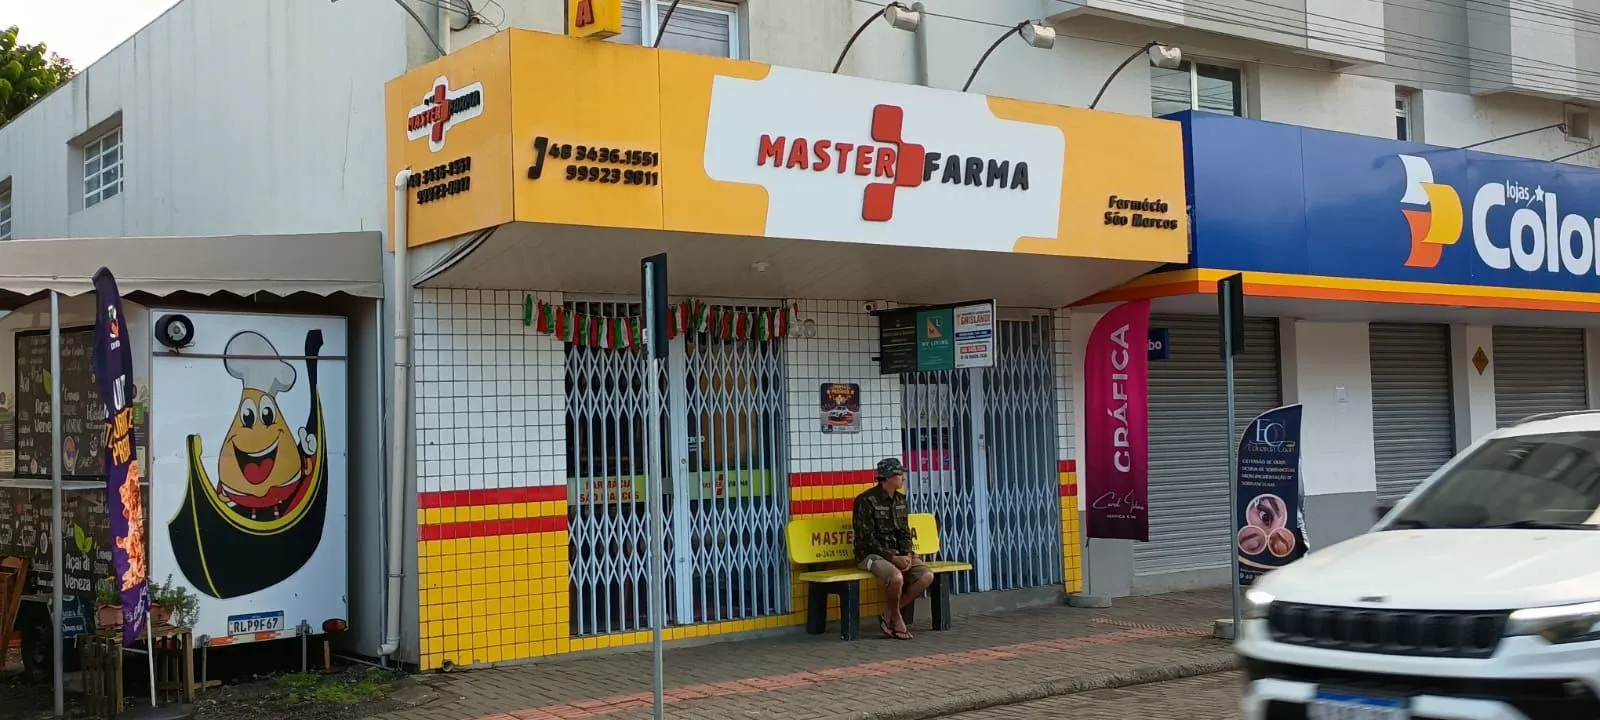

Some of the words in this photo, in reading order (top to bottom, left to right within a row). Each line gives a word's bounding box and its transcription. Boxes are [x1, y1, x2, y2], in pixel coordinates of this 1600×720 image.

[408, 105, 441, 132] MASTER
[549, 143, 572, 159] 48
[575, 145, 659, 167] 3436.1551
[757, 134, 896, 178] MASTER
[923, 152, 1030, 190] FARMA
[566, 165, 621, 184] 99923
[1506, 180, 1529, 203] lojas
[1104, 211, 1128, 226] São
[1131, 213, 1178, 230] Marcos
[1472, 182, 1600, 275] Colo
[1107, 324, 1131, 473] GRÁFICA
[811, 531, 853, 546] MASTE
[65, 574, 91, 592] Veneza
[234, 617, 278, 633] RLP9F67
